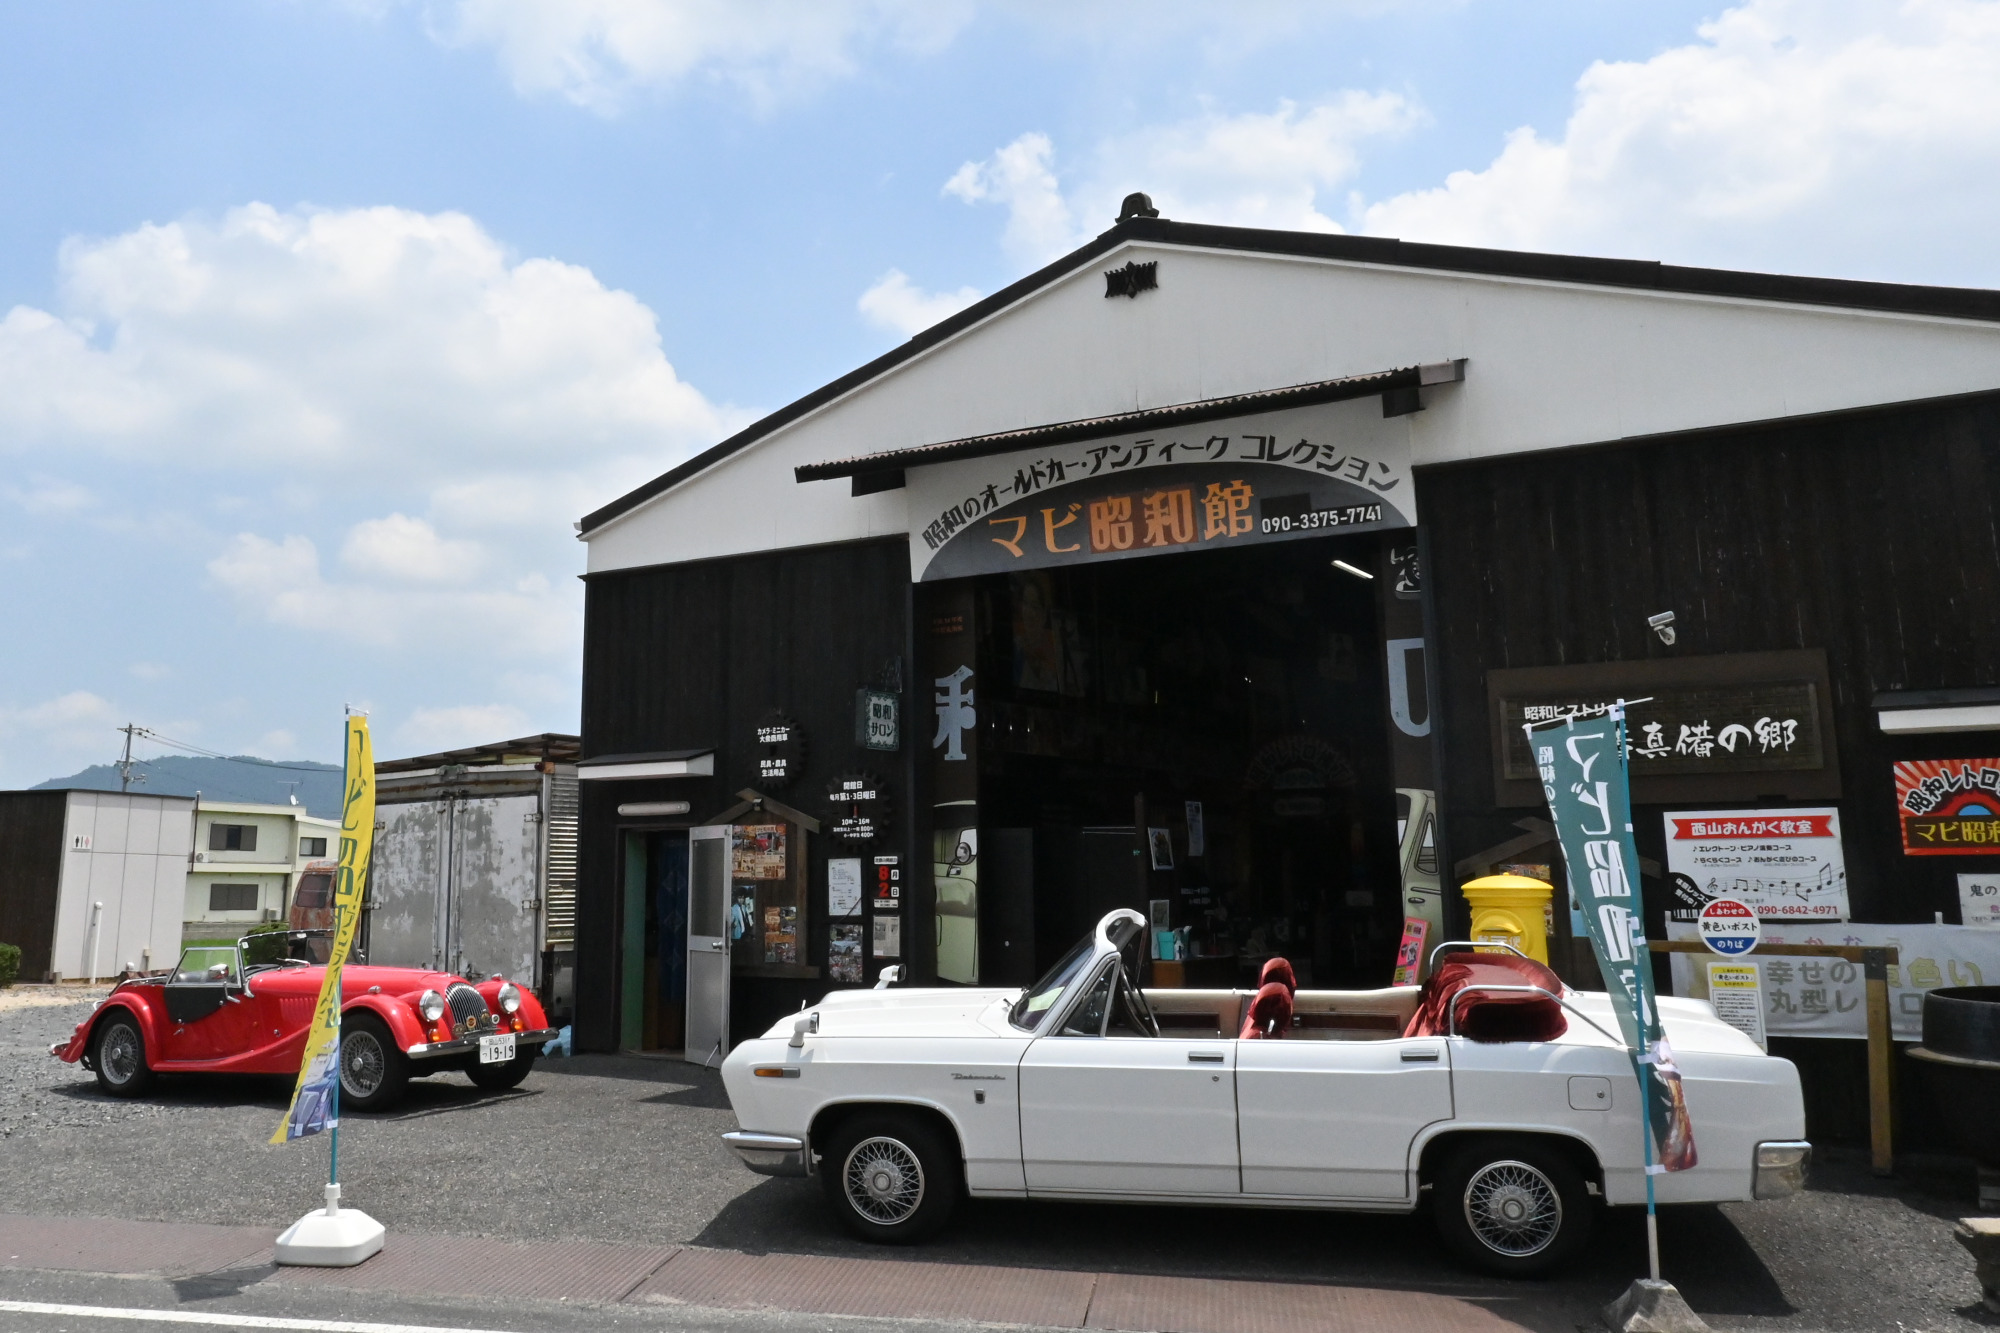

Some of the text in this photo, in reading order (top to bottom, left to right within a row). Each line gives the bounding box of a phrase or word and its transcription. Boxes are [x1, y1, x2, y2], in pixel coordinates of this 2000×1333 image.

[1240, 435, 1401, 492] コレクション
[989, 480, 1254, 558] マビ昭和館
[1262, 504, 1382, 534] 090-3375-7741
[872, 703, 892, 719] 昭和
[871, 722, 893, 737] サロン
[761, 768, 785, 777] 生活用品
[843, 780, 863, 790] 開館日
[1690, 820, 1813, 836] 西山おんがく教室
[879, 866, 889, 880] 8
[879, 883, 889, 897] 2
[1758, 906, 1838, 915] 090-6842-4971
[1701, 921, 1758, 932] 黄色いポスト
[1717, 939, 1745, 949] のりば
